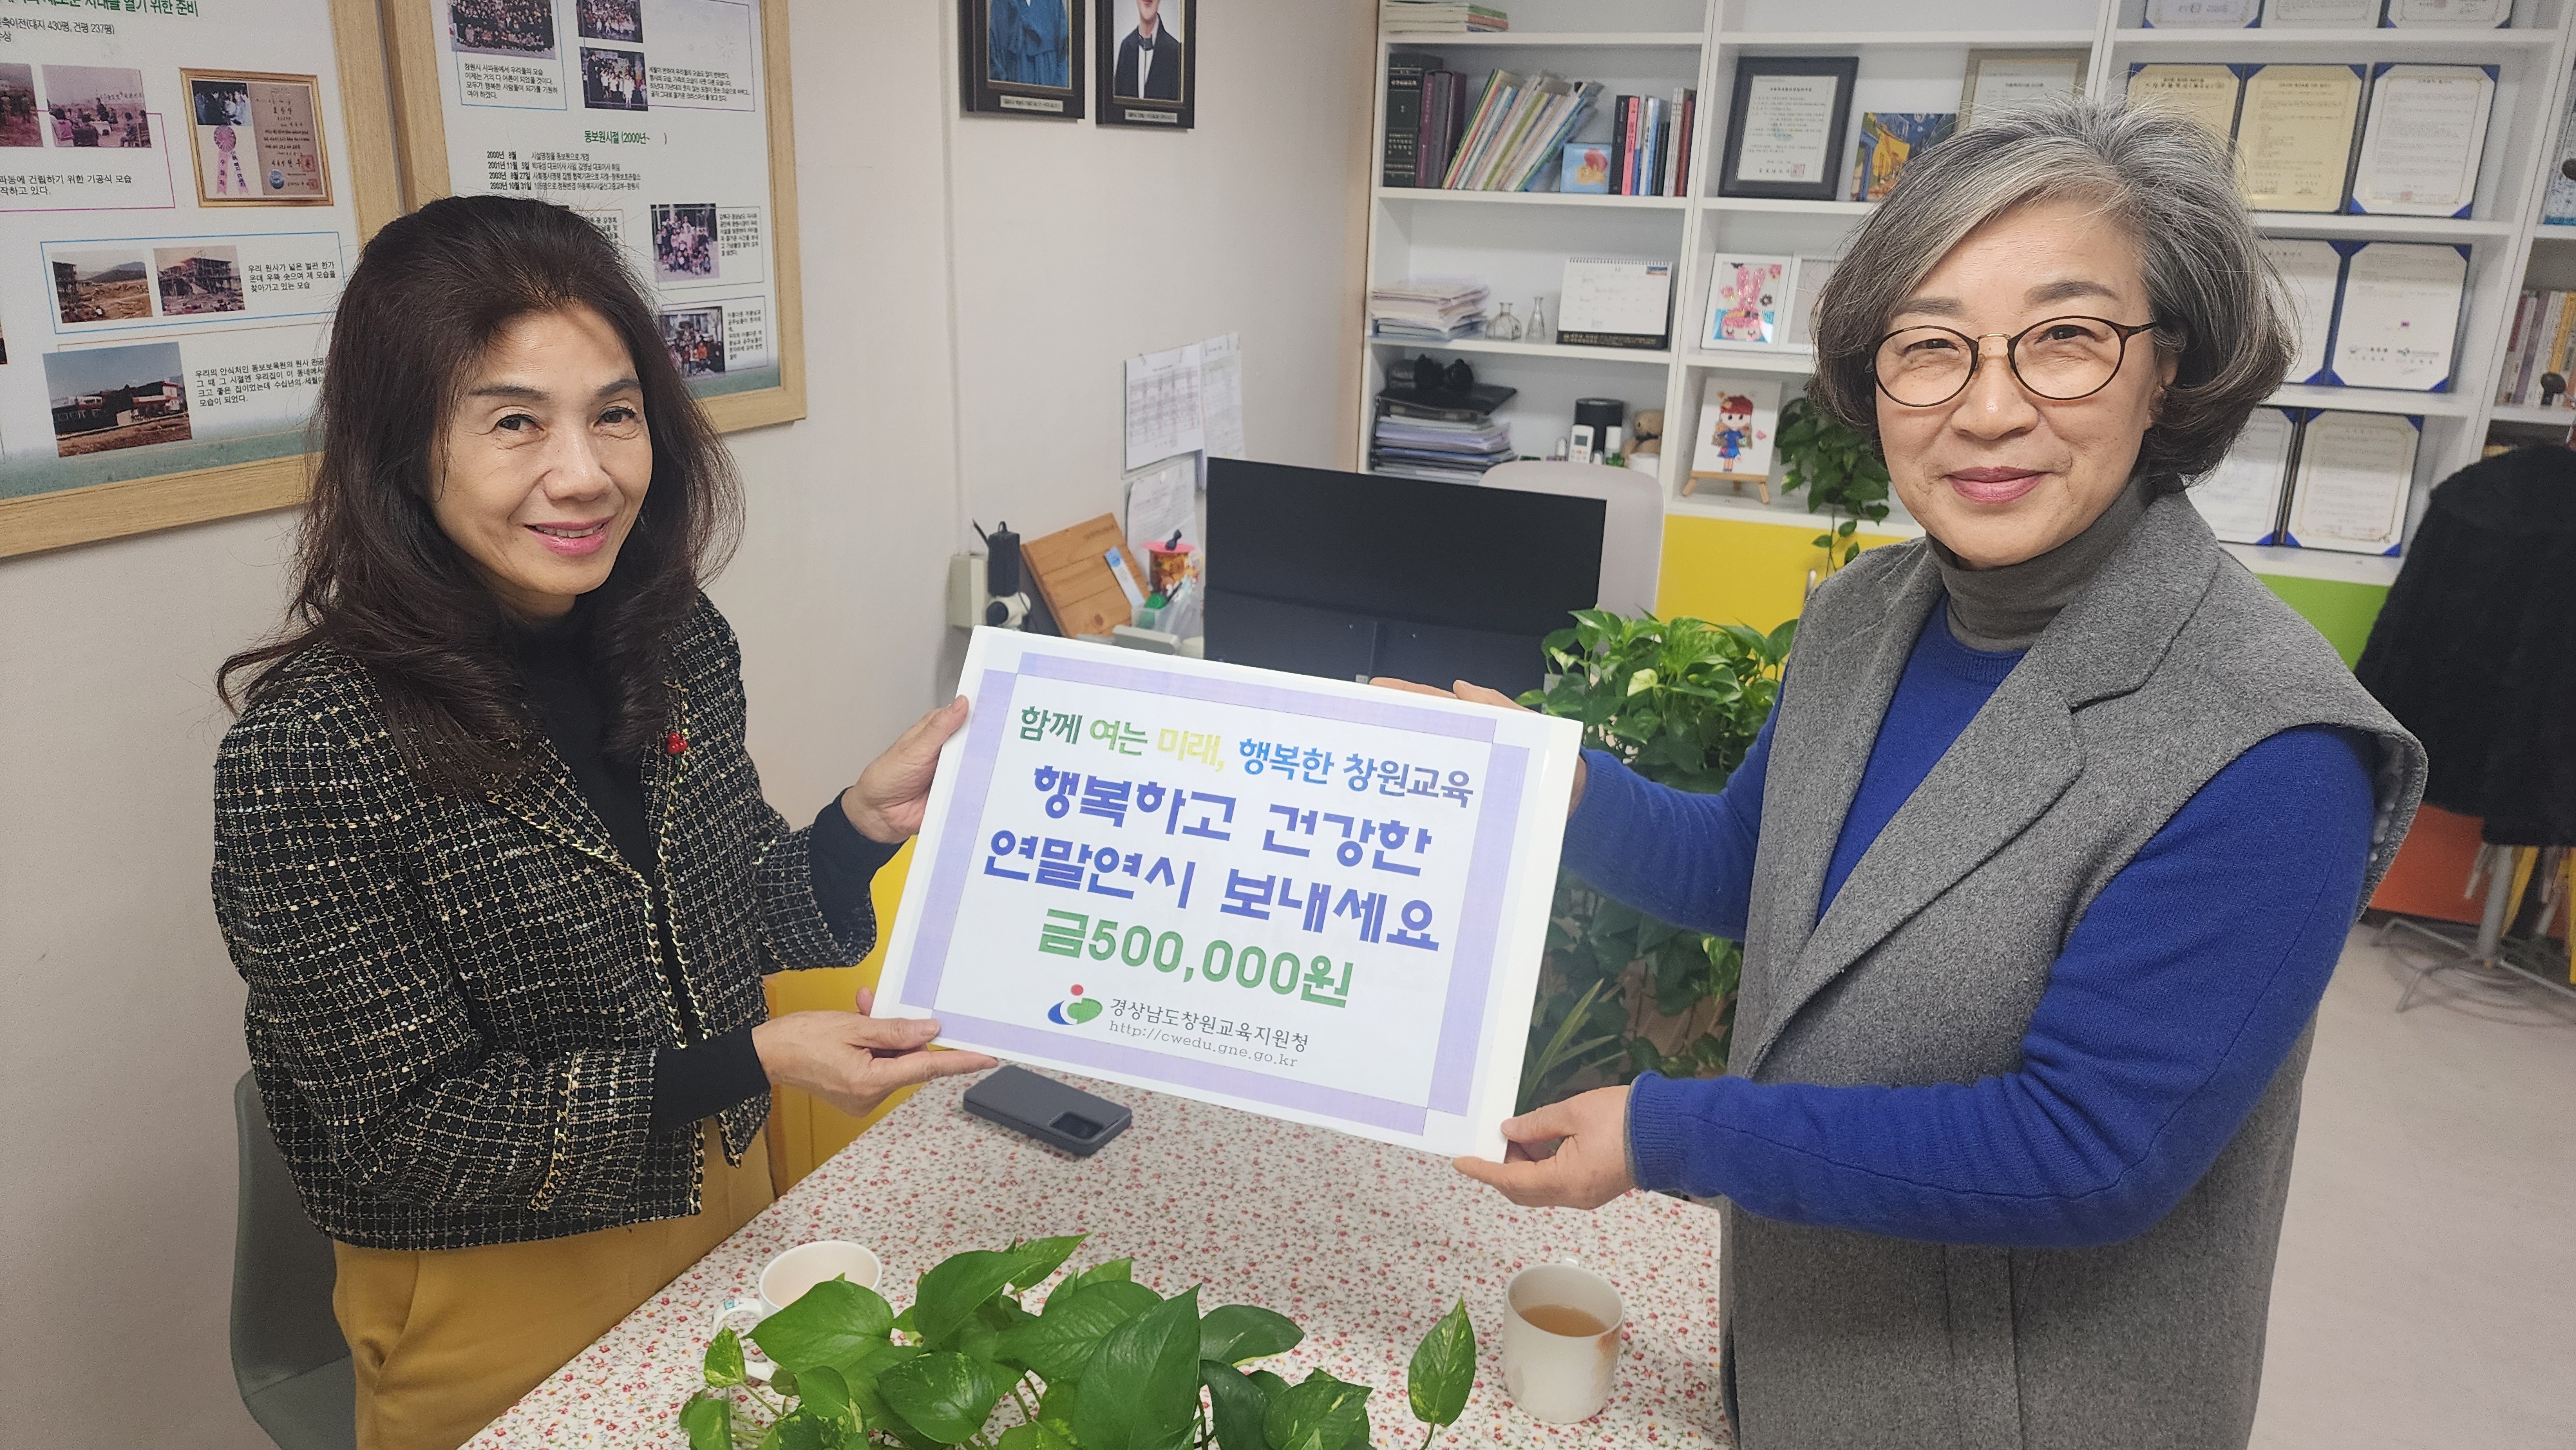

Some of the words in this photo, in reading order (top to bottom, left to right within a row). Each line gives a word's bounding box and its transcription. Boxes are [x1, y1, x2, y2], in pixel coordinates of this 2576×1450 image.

[150, 0, 173, 15] 위한
[175, 0, 198, 17] 준비
[0, 17, 44, 30] 축이전(대지
[73, 22, 89, 33] 건평
[584, 129, 620, 144] 동보원시절
[28, 174, 64, 184] 건립하기
[67, 174, 84, 184] 위한
[88, 174, 112, 184] 기공식
[115, 174, 132, 184] 모습
[248, 265, 262, 274] 우리
[321, 261, 334, 270] 한가
[283, 272, 304, 281] 솟으며
[316, 270, 336, 279] 모습을
[251, 283, 279, 293] 찾아가고
[281, 282, 295, 291] 있는
[297, 281, 310, 289] 모습
[195, 369, 217, 378] 우리의
[295, 359, 309, 367] 원사
[219, 377, 227, 386] 그
[255, 370, 283, 382] 우리집이
[287, 370, 294, 378] 이
[198, 388, 214, 397] 크고
[199, 397, 222, 407] 모습이
[225, 394, 249, 404] 되었다.
[1019, 706, 1083, 745] 함께
[1090, 719, 1148, 756] 여는
[1157, 728, 1224, 772] 미래,
[1239, 738, 1335, 785] 행복한
[1343, 753, 1474, 809] 창원교육
[1034, 764, 1236, 842] 행복하고
[1262, 803, 1432, 877] 건강한
[983, 829, 1196, 909] 연말연시
[1219, 868, 1439, 952] 보내세요
[1037, 908, 1354, 1009] 금500,000원
[1110, 998, 1309, 1053] 경상남도창원교육지원청
[1108, 1020, 1298, 1067] http://cwedu.gne.go.kr
